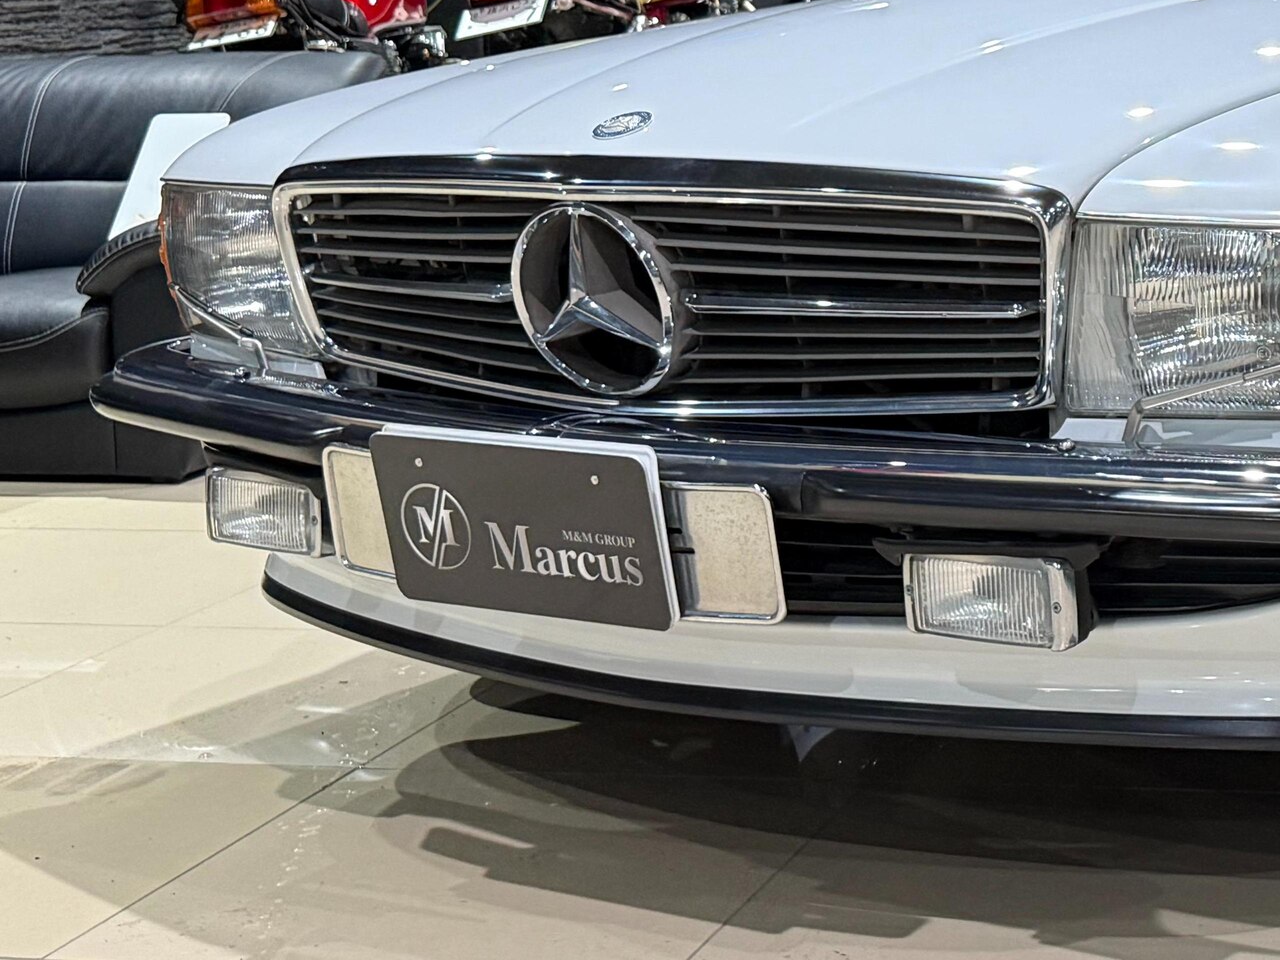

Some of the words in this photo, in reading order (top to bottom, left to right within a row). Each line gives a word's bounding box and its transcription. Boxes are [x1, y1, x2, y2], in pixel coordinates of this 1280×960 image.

[484, 521, 643, 586] Marcus
[561, 529, 593, 544] M&M
[595, 533, 635, 548] GROUP
